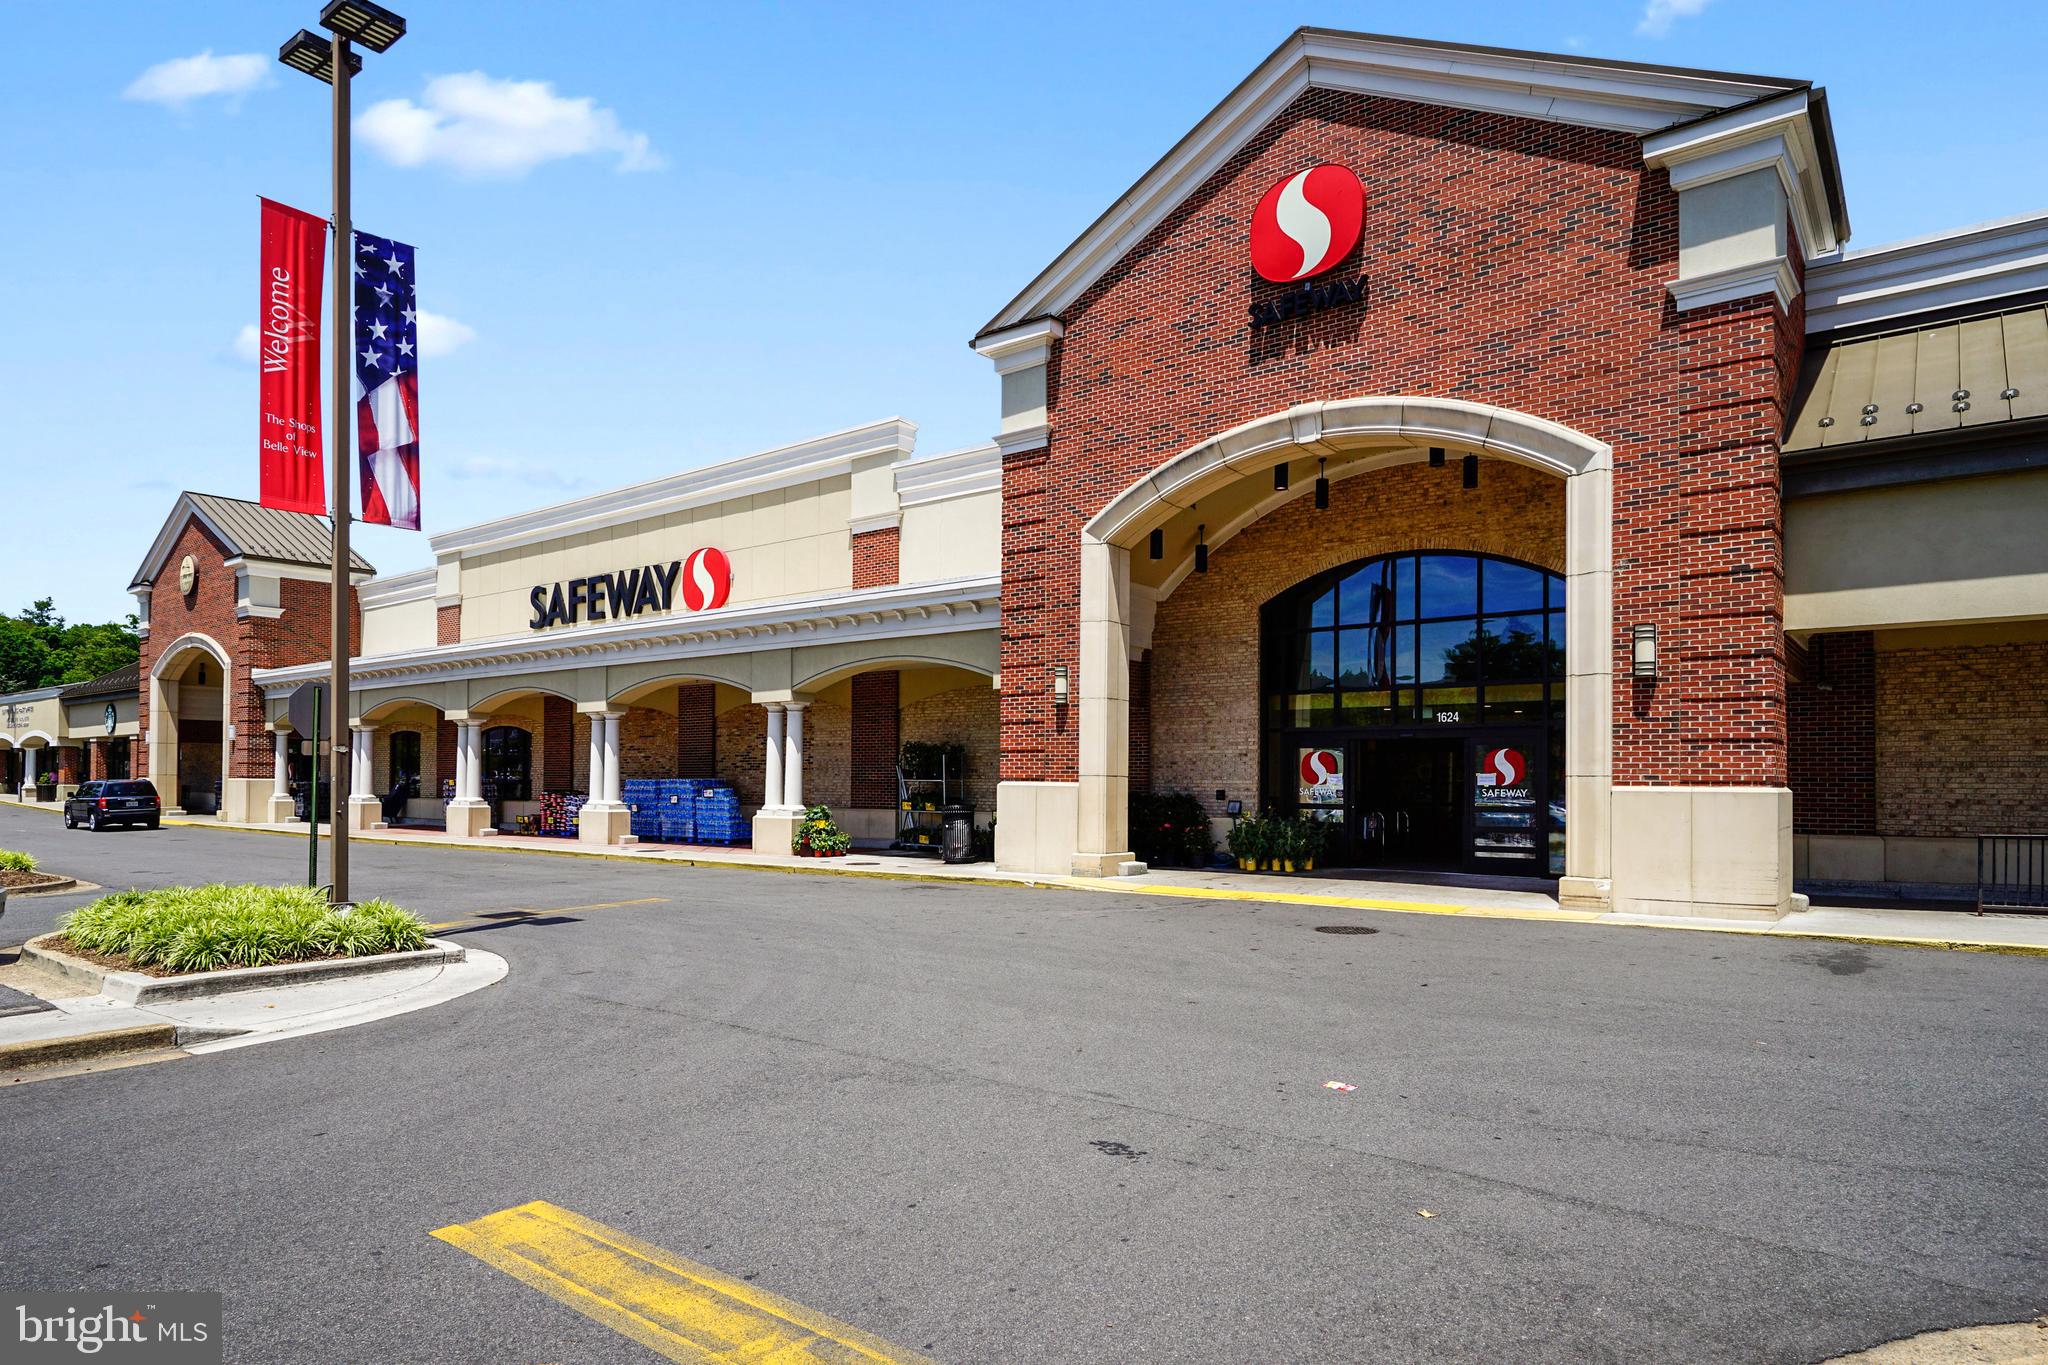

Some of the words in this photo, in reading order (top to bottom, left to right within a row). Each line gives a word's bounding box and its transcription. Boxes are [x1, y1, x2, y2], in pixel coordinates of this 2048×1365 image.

[1248, 274, 1370, 328] SAFEWAY
[264, 267, 290, 373] Welcome
[265, 412, 285, 426] The
[289, 418, 316, 434] Shops
[286, 432, 297, 441] of
[263, 438, 289, 453] Belle
[293, 445, 317, 459] View
[529, 560, 681, 629] SAFEWAY
[1436, 711, 1460, 723] 1624
[1481, 788, 1528, 798] SAFEWAY
